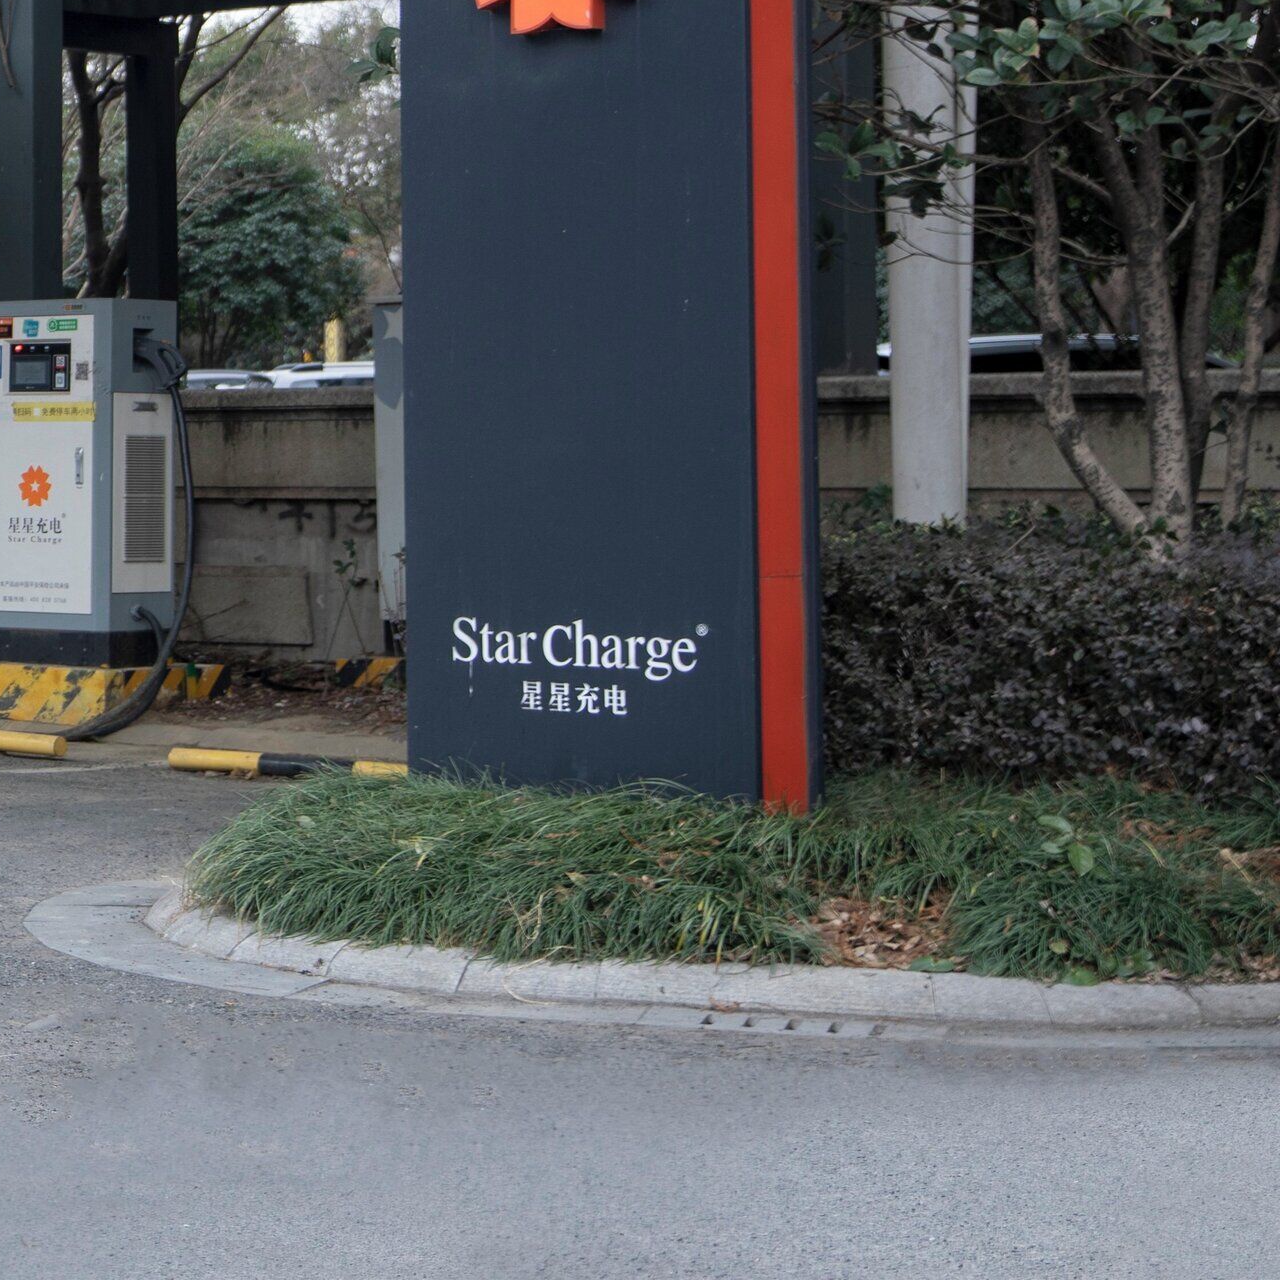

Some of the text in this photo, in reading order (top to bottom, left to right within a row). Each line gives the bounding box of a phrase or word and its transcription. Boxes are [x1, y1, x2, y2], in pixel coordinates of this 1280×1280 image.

[8, 517, 63, 534] 星星充电
[8, 535, 62, 544] Star Charge
[452, 616, 698, 681] Star Charge
[521, 680, 628, 715] 星星充电
